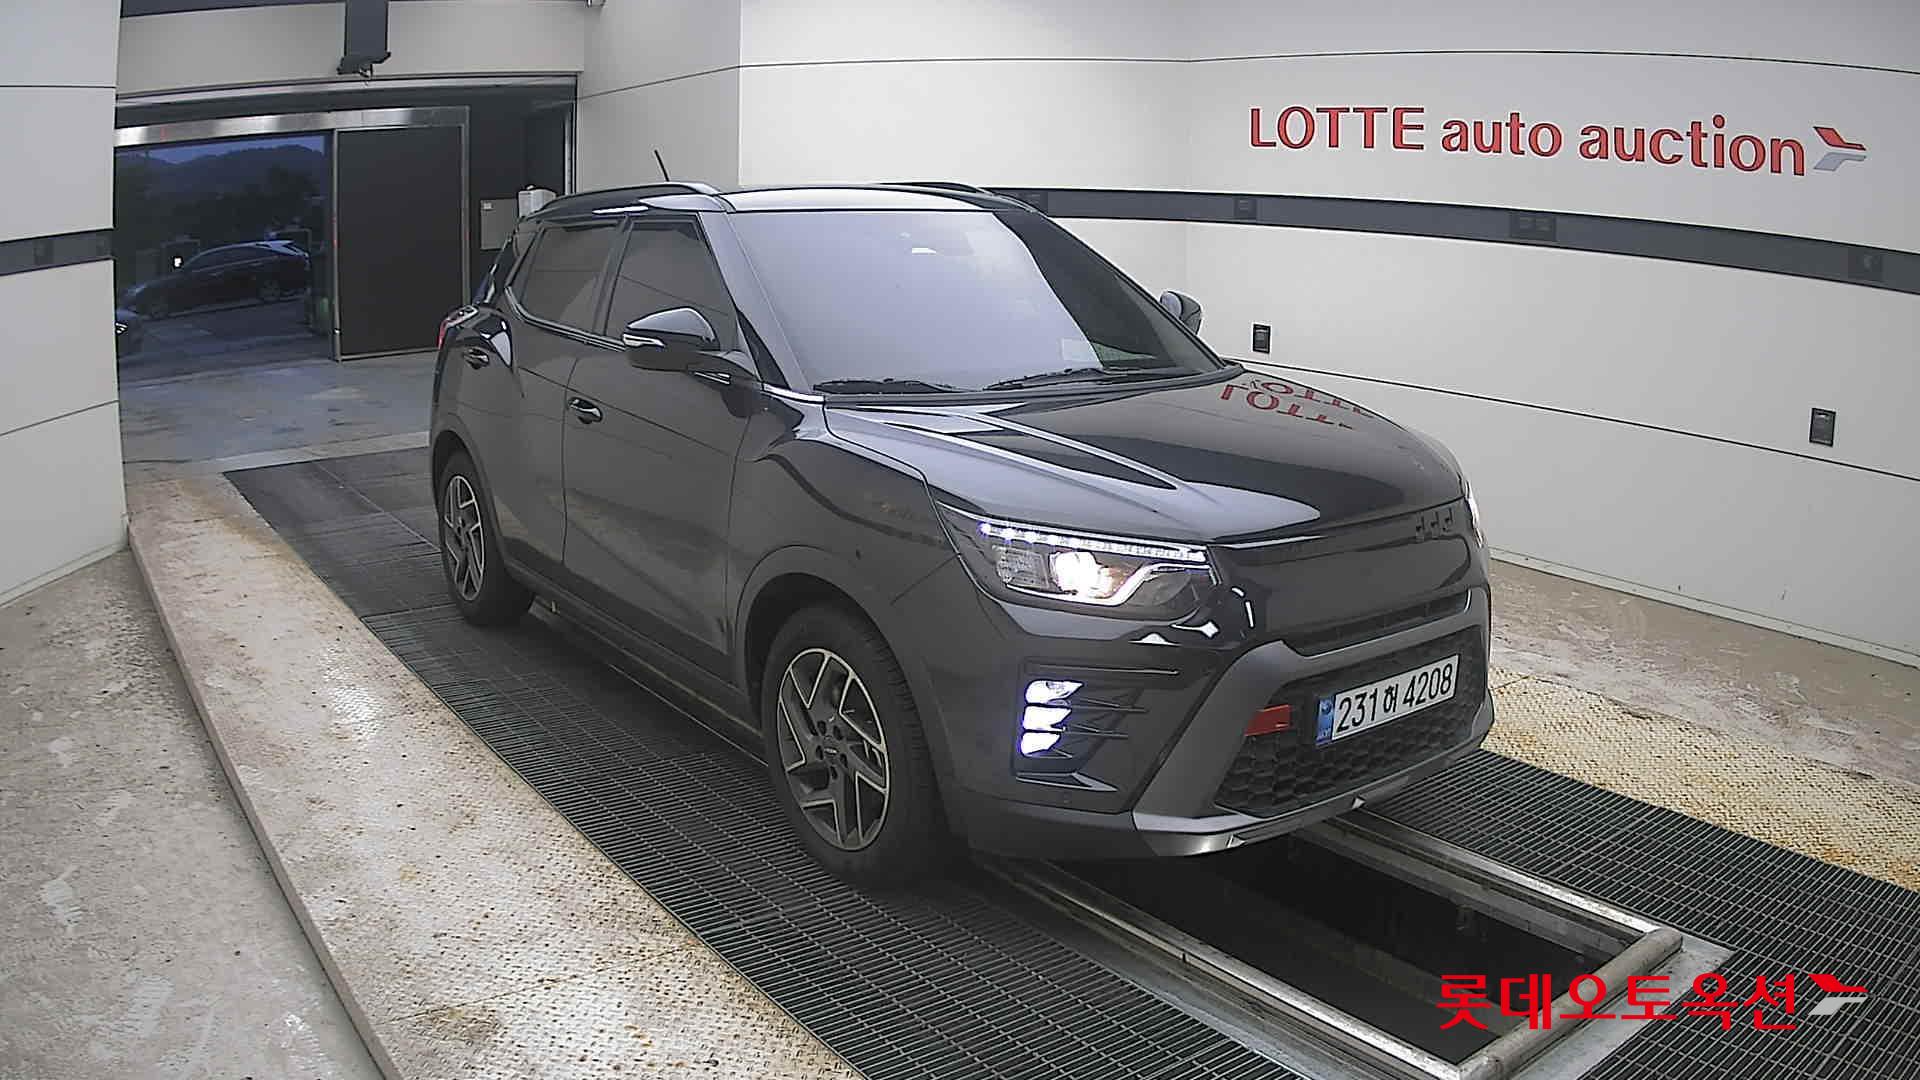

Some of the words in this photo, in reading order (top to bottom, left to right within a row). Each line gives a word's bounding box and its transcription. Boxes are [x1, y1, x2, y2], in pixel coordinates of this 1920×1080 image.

[1249, 106, 1425, 151] LOTTE
[1440, 112, 1563, 157] auto
[1578, 114, 1806, 177] auction
[1402, 662, 1454, 707] 4208
